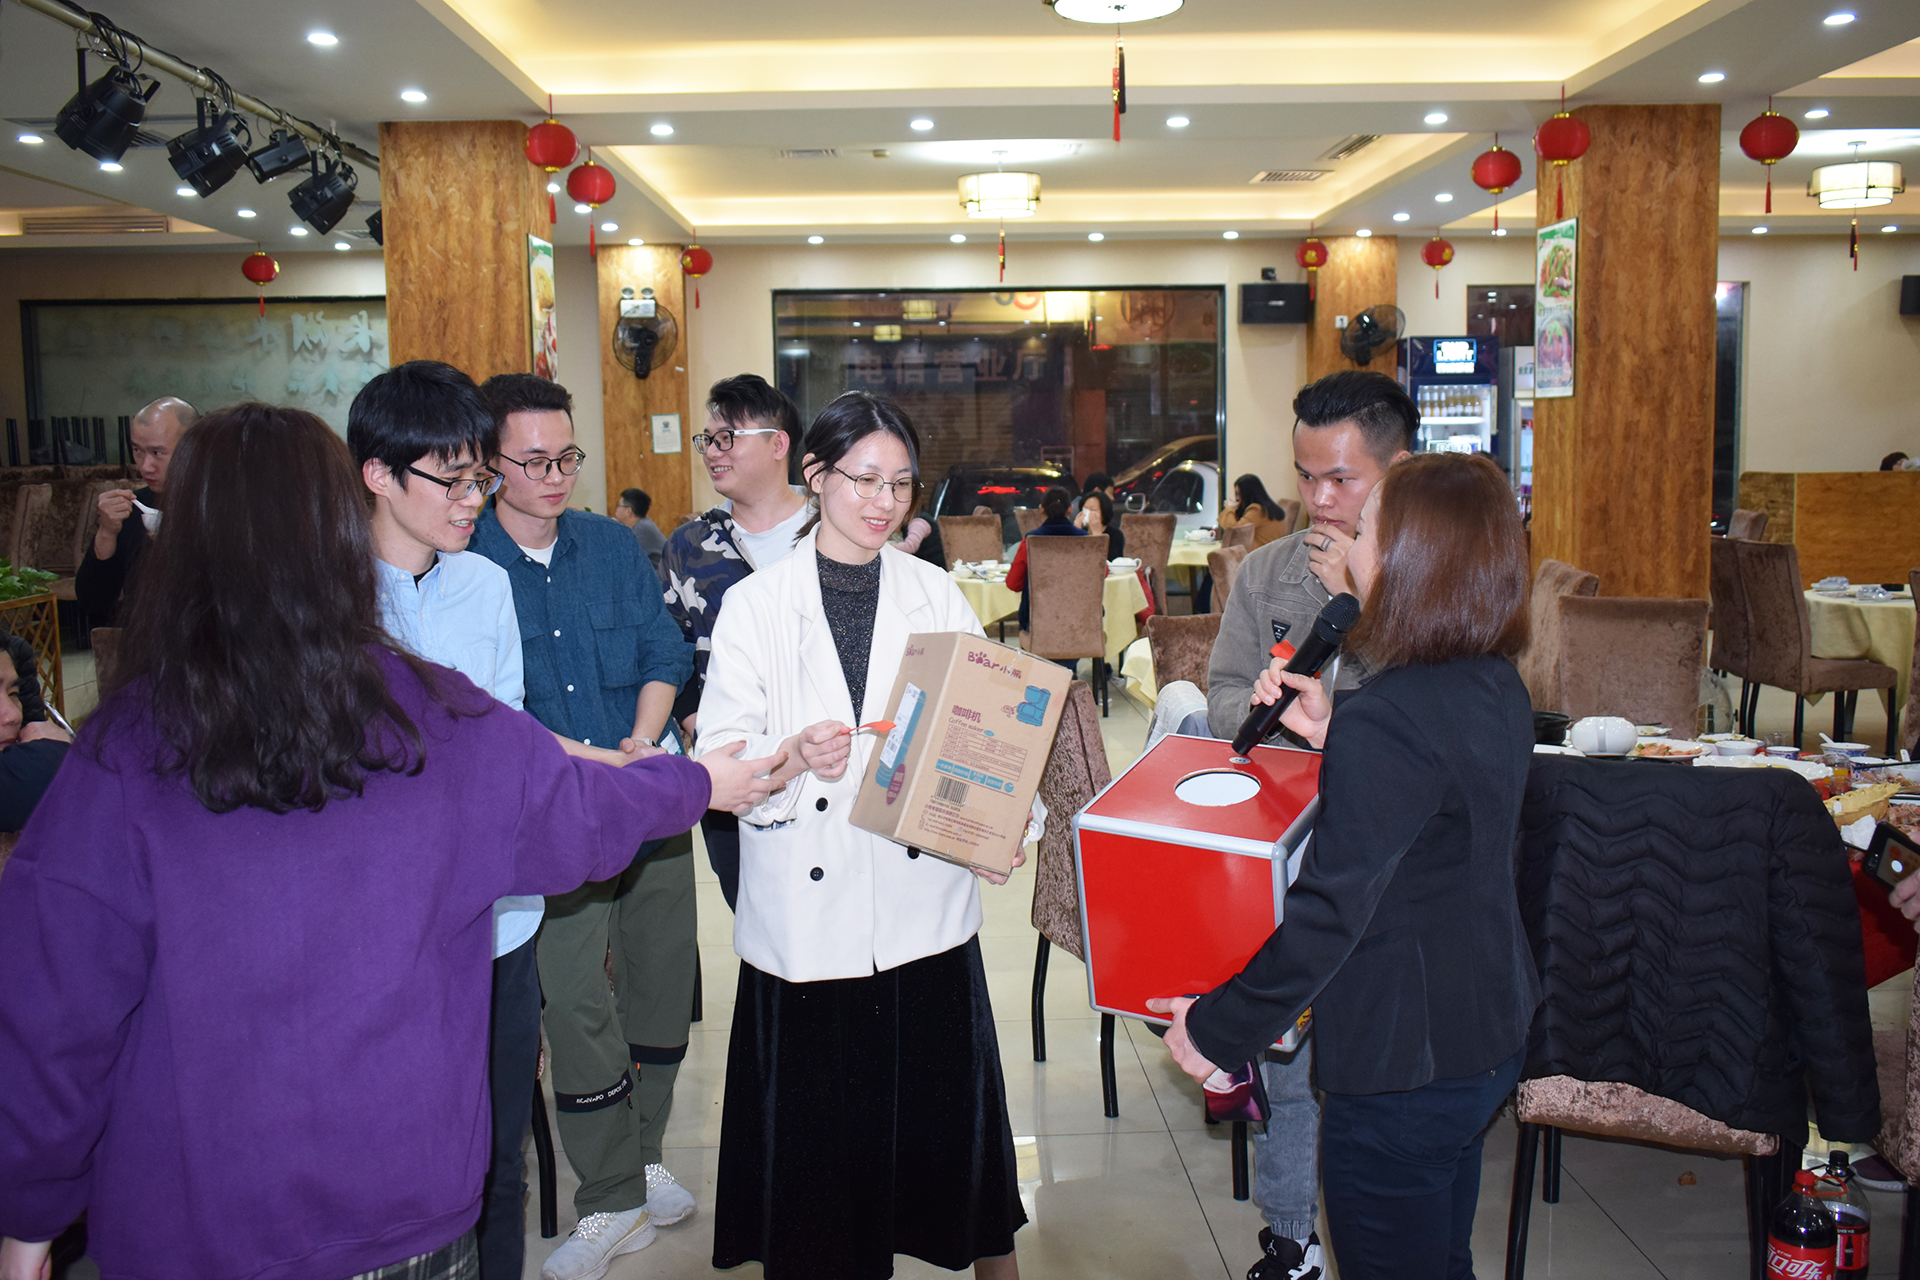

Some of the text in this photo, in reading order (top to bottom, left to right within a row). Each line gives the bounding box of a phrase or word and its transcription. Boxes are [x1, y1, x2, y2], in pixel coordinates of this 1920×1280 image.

[856, 349, 1046, 383] 电信营业厅
[948, 716, 967, 728] Coffee
[952, 704, 981, 723] 咖啡机
